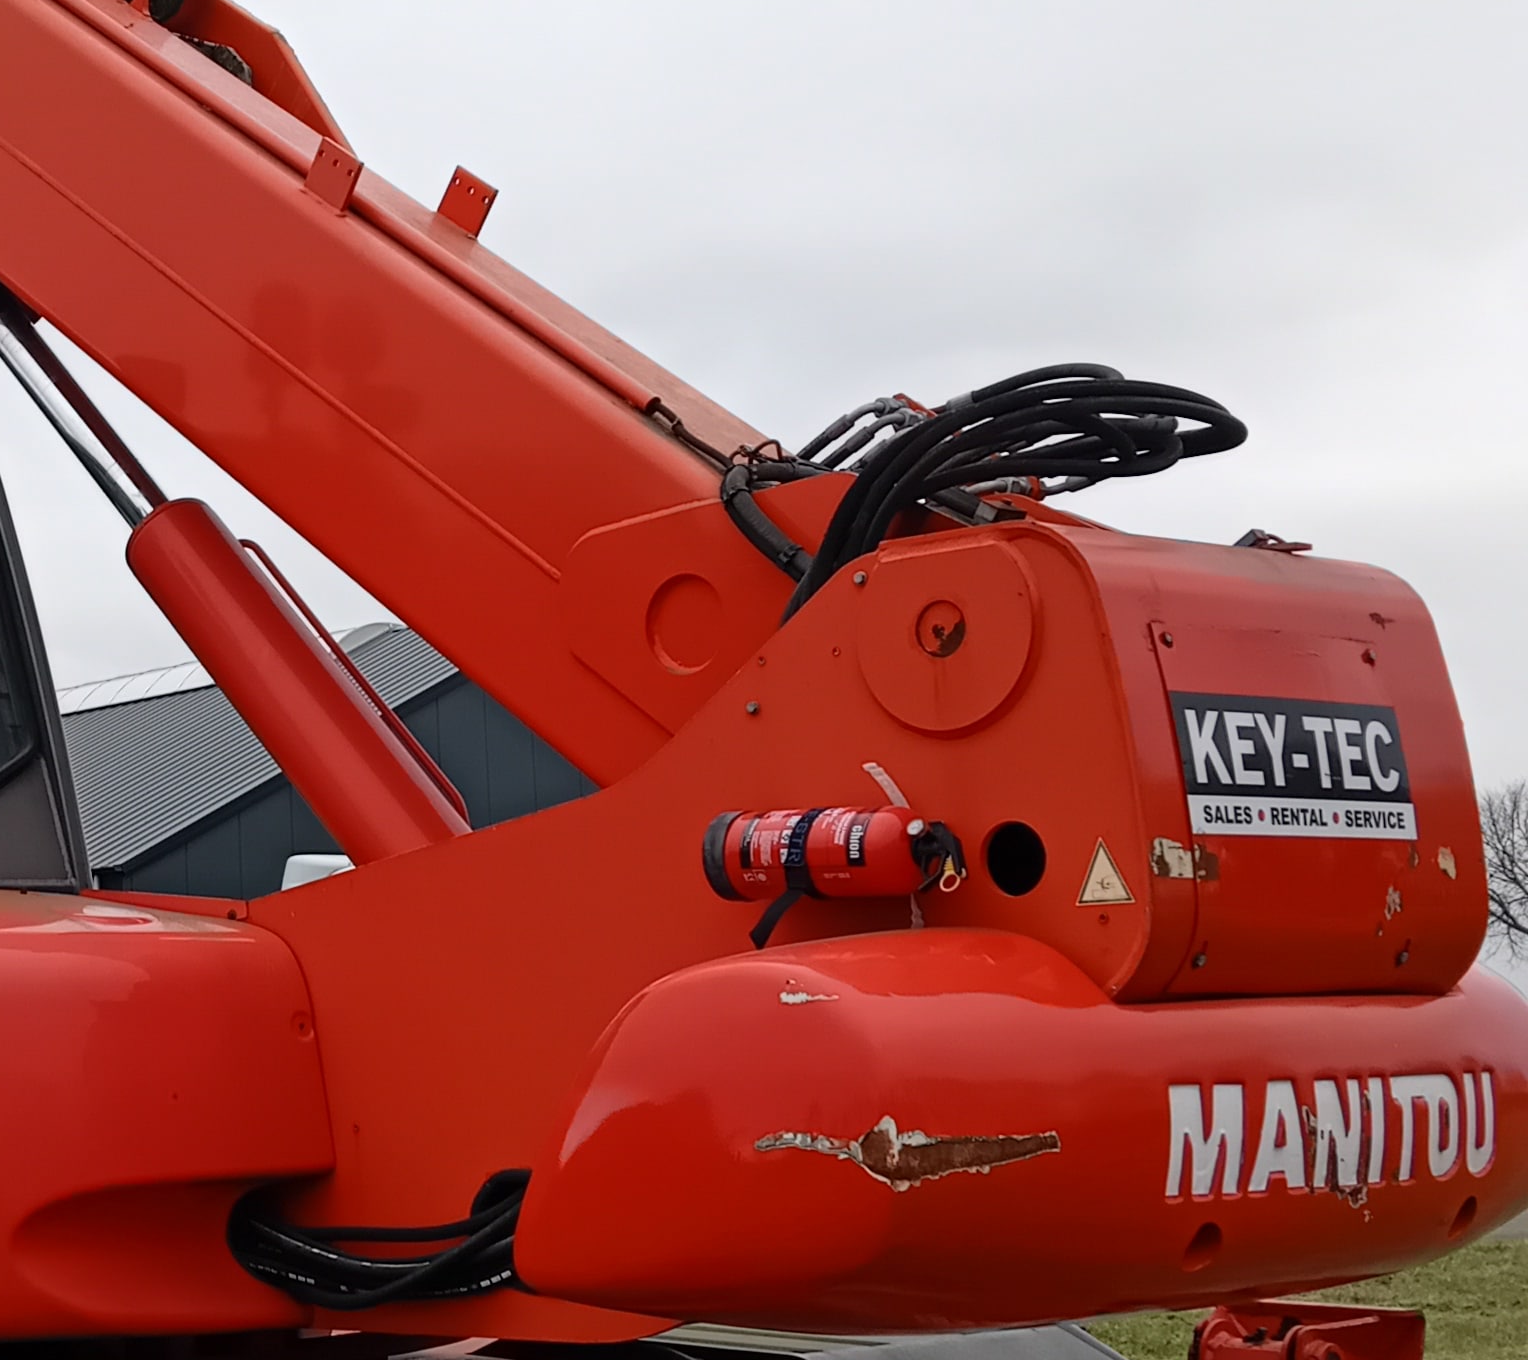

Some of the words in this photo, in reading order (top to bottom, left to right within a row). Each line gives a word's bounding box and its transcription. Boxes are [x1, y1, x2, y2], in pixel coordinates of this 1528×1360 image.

[1184, 708, 1401, 793] KEY-TEC
[1203, 804, 1253, 825] SALES
[1270, 806, 1328, 827] RENTAL
[1344, 809, 1406, 830] SERVICE
[1165, 1070, 1496, 1201] MANITOU
